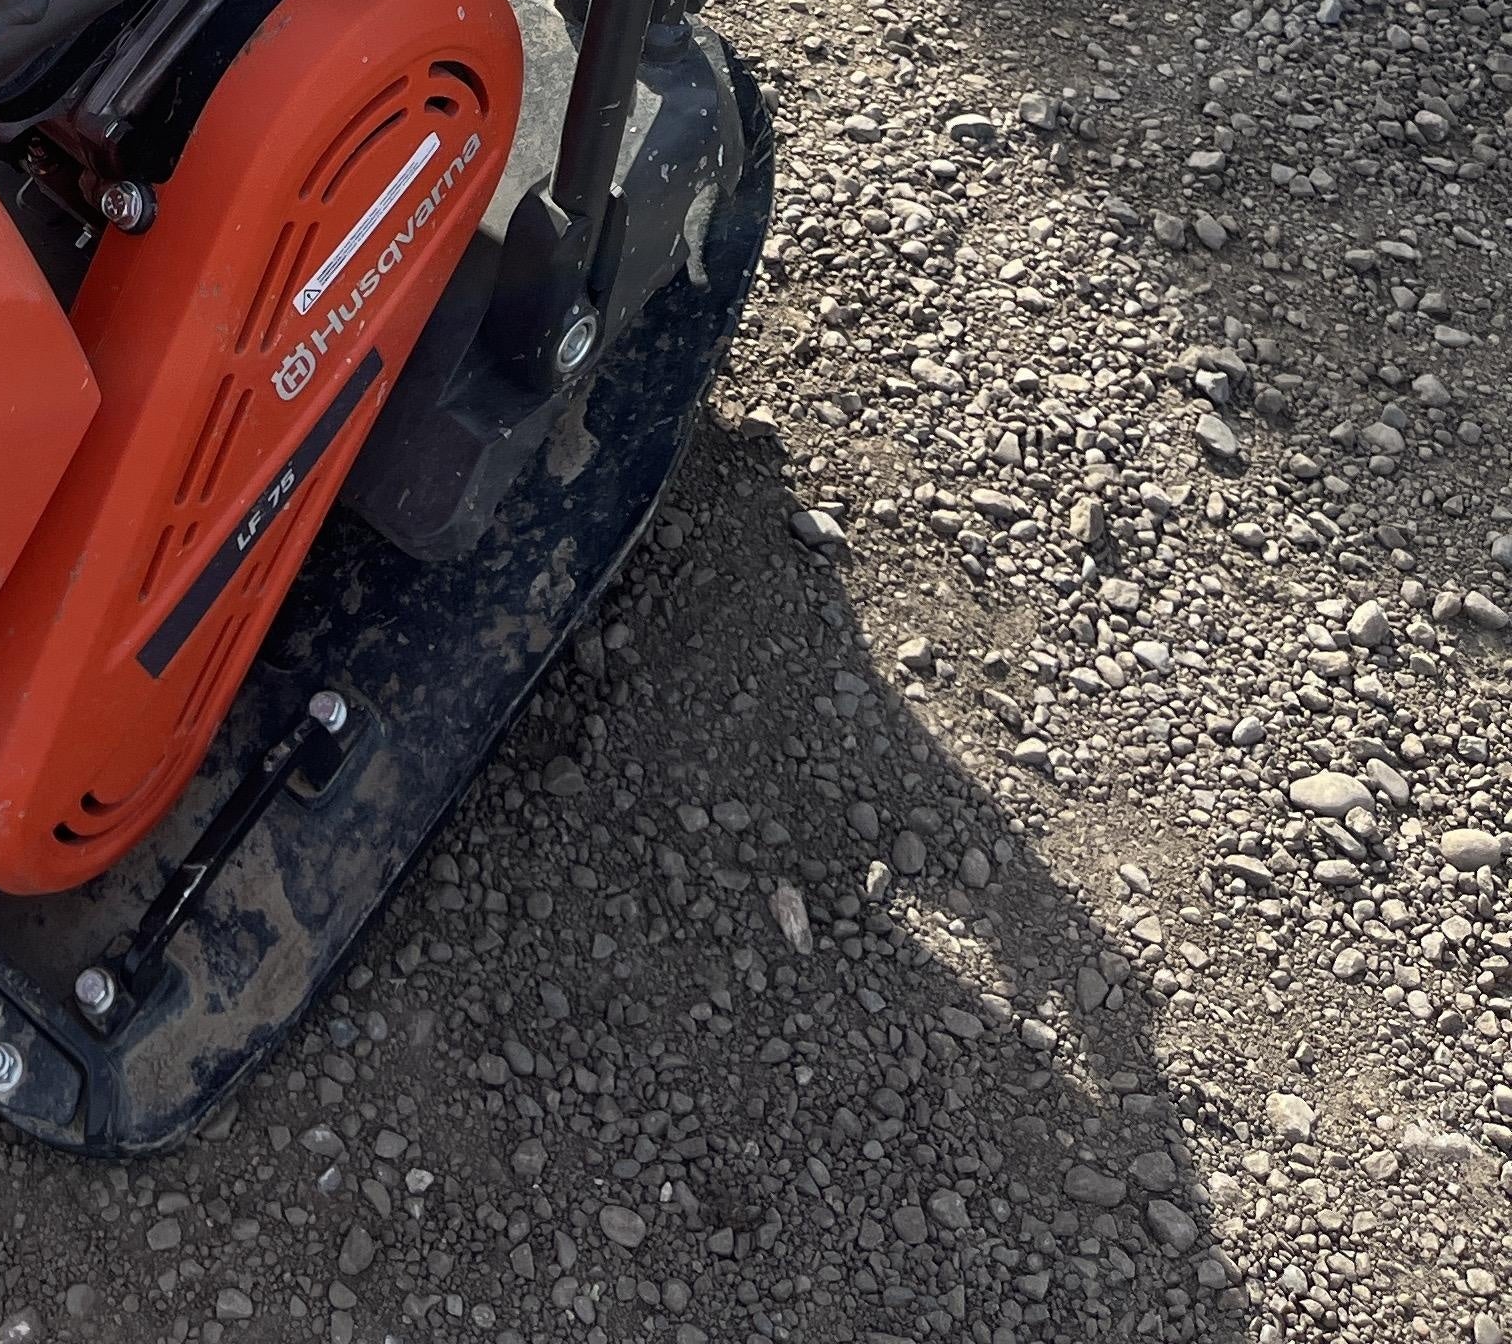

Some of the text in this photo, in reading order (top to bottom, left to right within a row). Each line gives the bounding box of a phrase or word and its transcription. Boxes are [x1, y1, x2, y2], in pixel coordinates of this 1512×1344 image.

[310, 132, 482, 355] Husqvarna
[236, 468, 295, 551] LF 75
